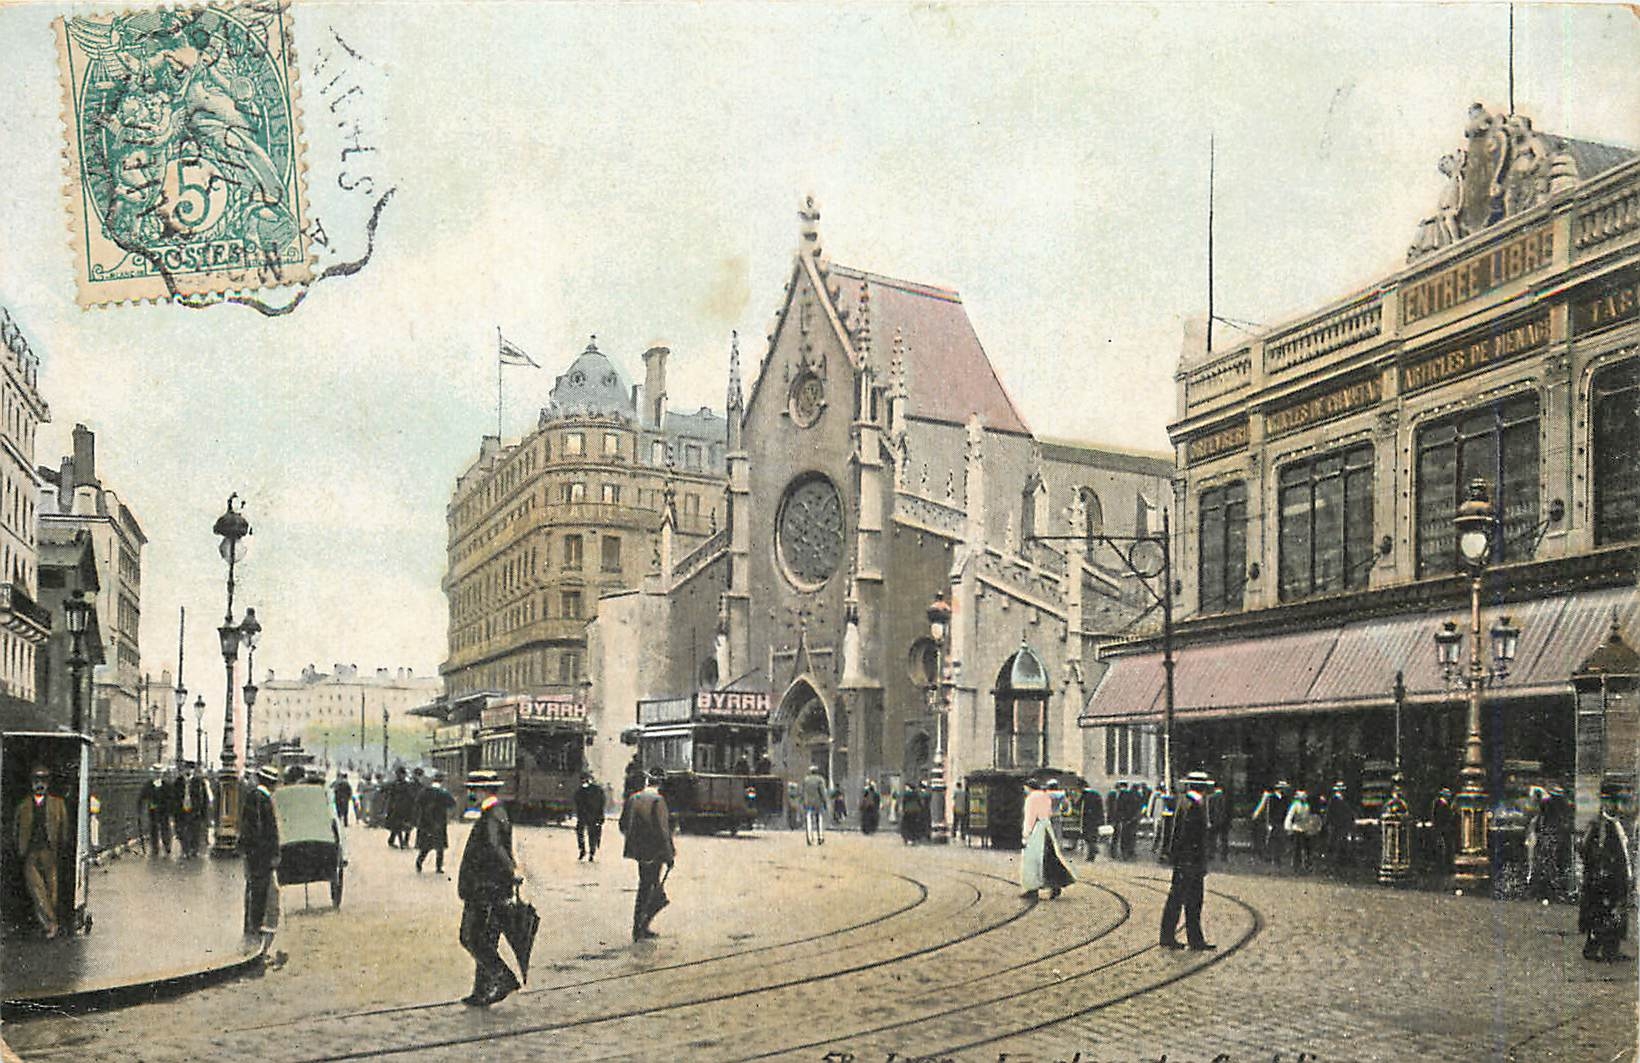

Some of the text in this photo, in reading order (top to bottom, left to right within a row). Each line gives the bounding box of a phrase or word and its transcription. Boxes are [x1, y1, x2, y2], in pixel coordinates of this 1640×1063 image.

[174, 157, 212, 227] 5
[1470, 338, 1490, 365] DE
[519, 702, 586, 717] BYRRH
[697, 692, 771, 709] BYRRH
